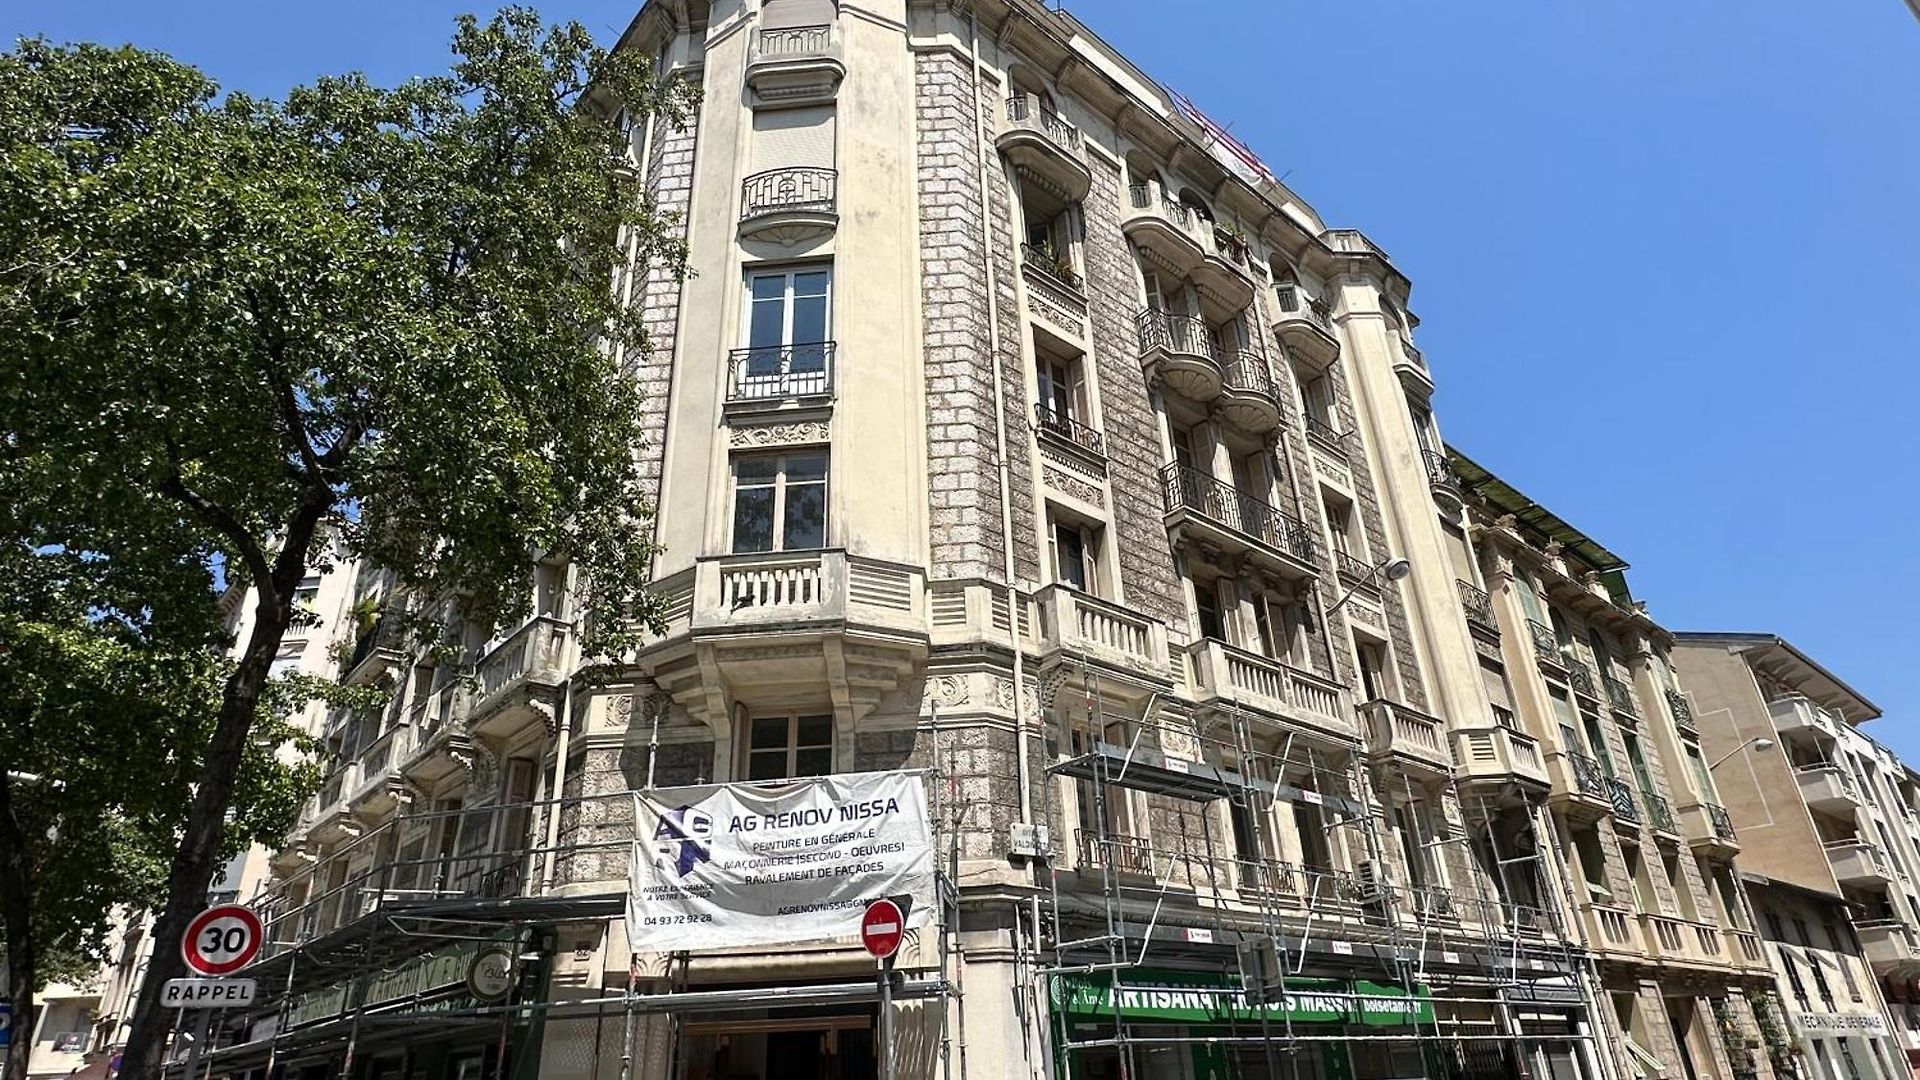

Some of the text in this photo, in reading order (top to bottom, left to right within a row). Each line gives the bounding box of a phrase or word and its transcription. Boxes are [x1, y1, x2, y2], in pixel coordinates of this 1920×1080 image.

[729, 798, 899, 833] AG RENOV NISSA
[753, 838, 802, 851] PEINTURE
[805, 837, 819, 847] EN
[723, 856, 794, 872] MAÇONNERIE
[745, 862, 884, 886] RAVALEMENT DE FAÇADES
[644, 913, 712, 925] 04 93 72 92 28
[201, 927, 245, 953] 30
[167, 985, 249, 1000] RAPPEL
